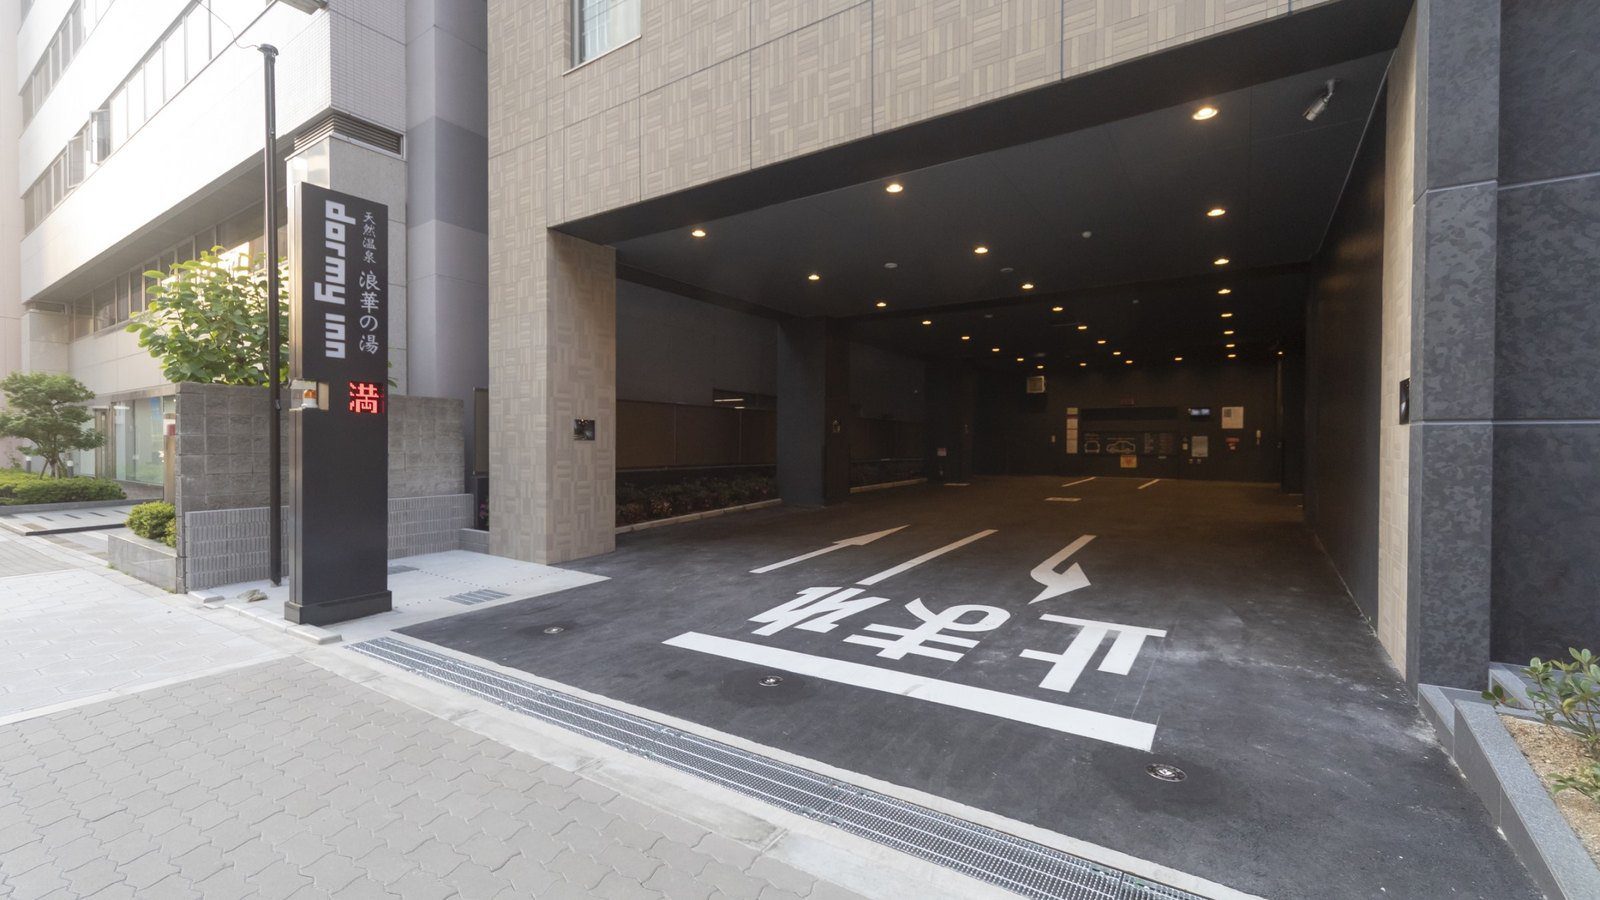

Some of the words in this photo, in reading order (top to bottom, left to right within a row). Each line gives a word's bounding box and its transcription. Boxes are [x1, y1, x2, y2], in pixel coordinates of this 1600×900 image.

[315, 200, 356, 305] dormy
[362, 211, 377, 264] 天然温泉
[325, 313, 346, 359] inn
[359, 271, 381, 355] 浪華の湯
[349, 382, 379, 414] 満
[749, 586, 1167, 693] 止まれ
